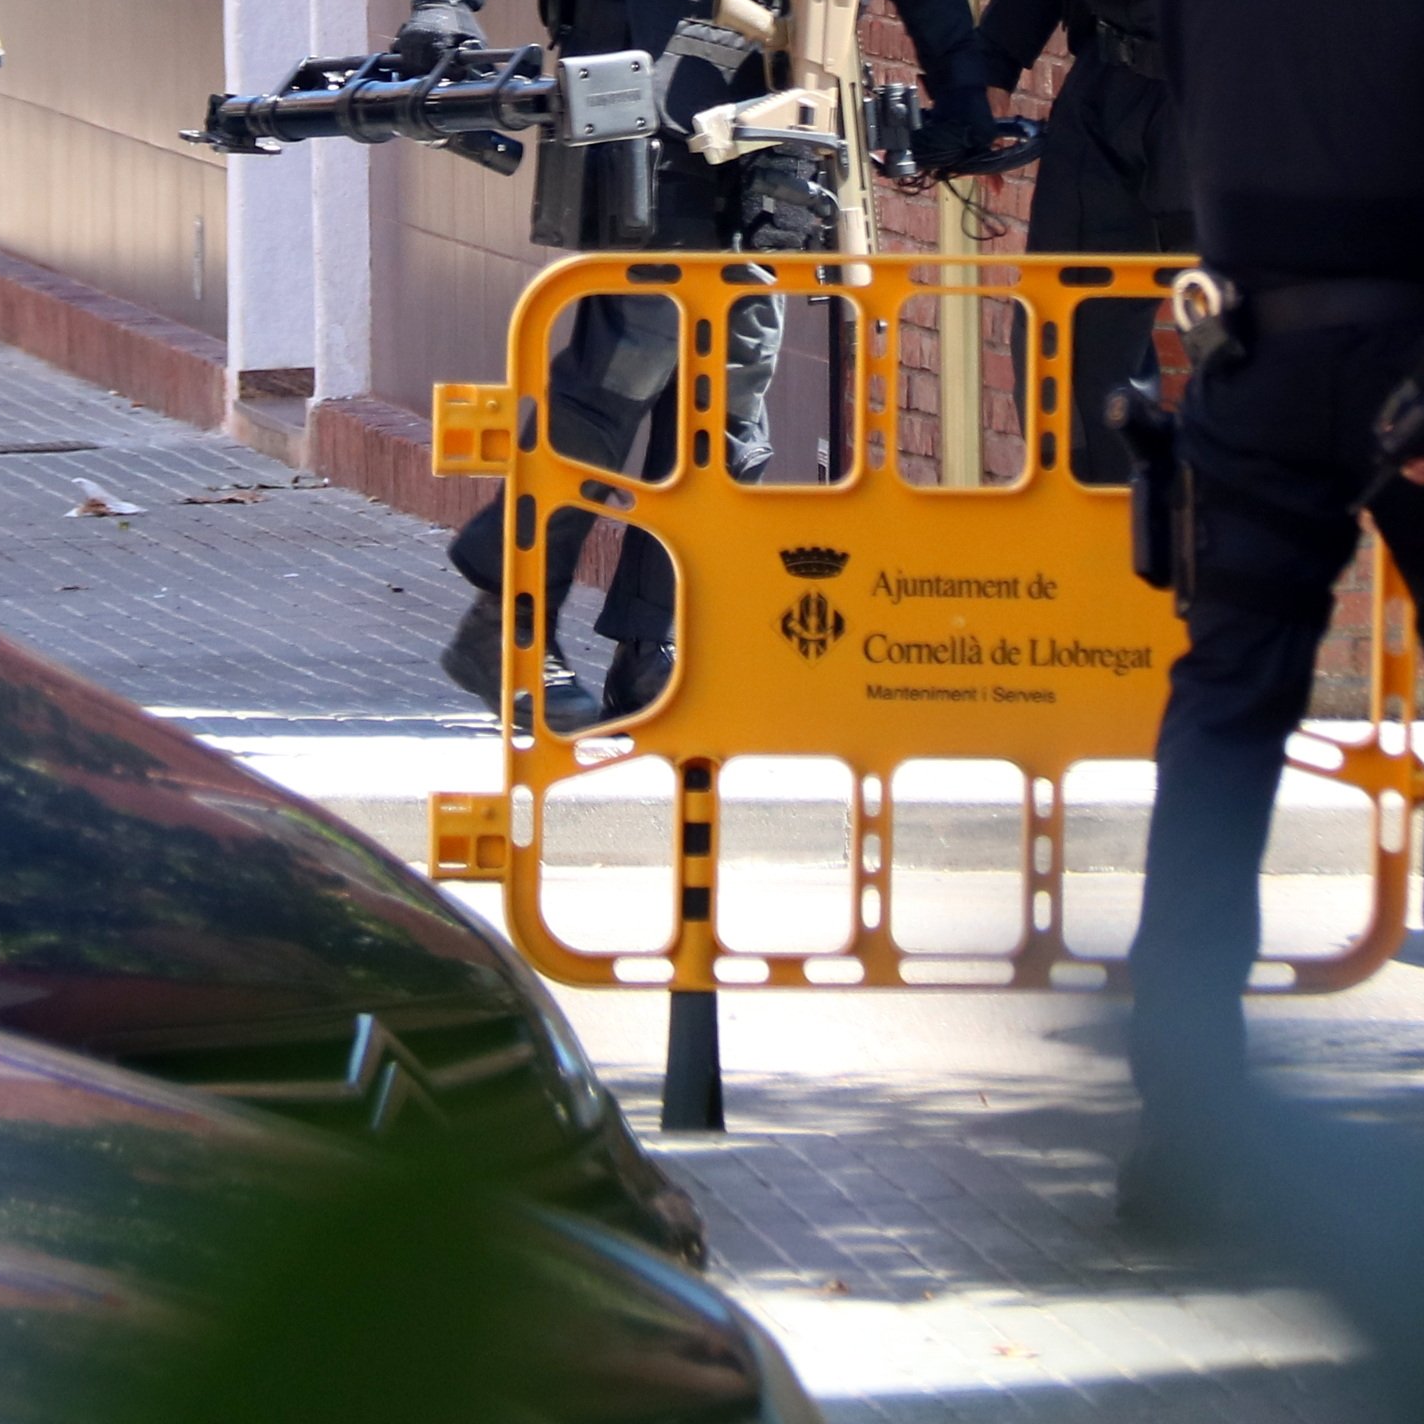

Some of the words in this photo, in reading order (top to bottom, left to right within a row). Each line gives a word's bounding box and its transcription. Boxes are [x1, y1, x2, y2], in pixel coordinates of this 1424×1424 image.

[871, 570, 1020, 605] Ajuntament
[1027, 573, 1057, 599] de
[863, 632, 984, 666] Cornellà
[991, 638, 1021, 666] de
[1029, 639, 1152, 676] Llobregat
[866, 684, 977, 702] Manteniment
[992, 686, 1056, 703] Serveis
